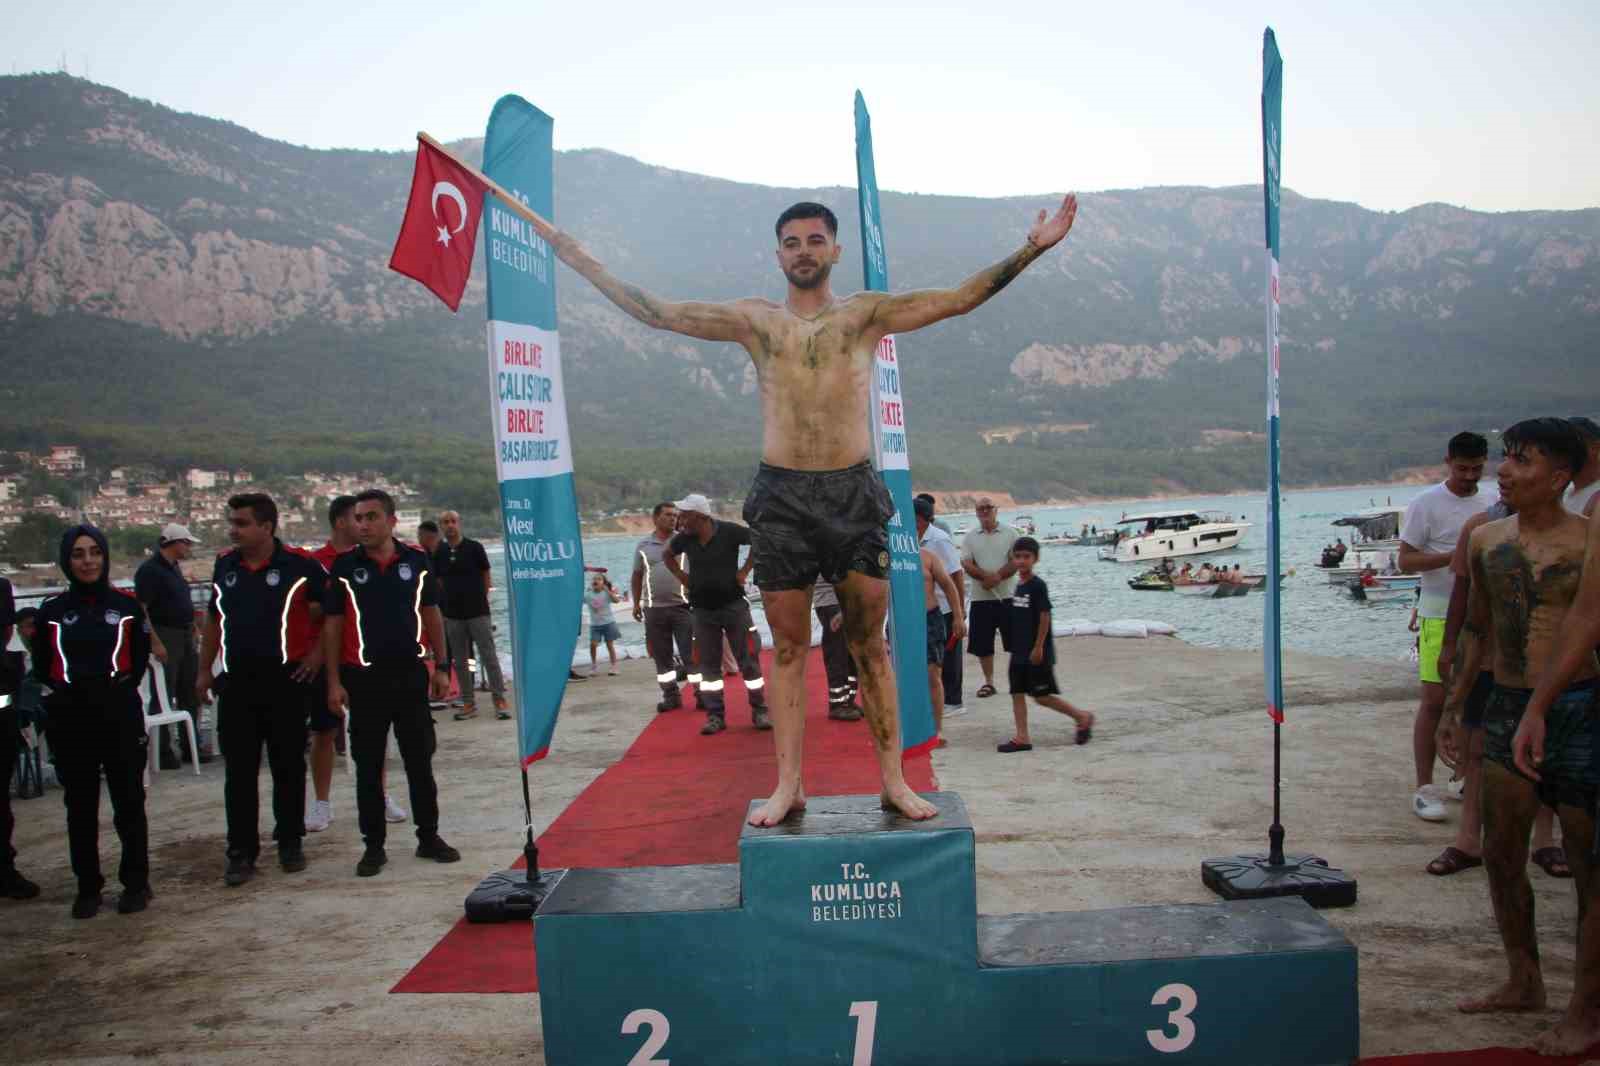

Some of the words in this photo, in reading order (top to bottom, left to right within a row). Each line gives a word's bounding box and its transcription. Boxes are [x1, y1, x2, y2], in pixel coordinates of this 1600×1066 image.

[841, 862, 870, 880] T.C.
[810, 881, 902, 902] KUMLUCA
[812, 899, 902, 921] BELEDİYESİ
[621, 1008, 670, 1066] 2
[848, 1000, 878, 1066] 1
[1146, 983, 1198, 1052] 3
